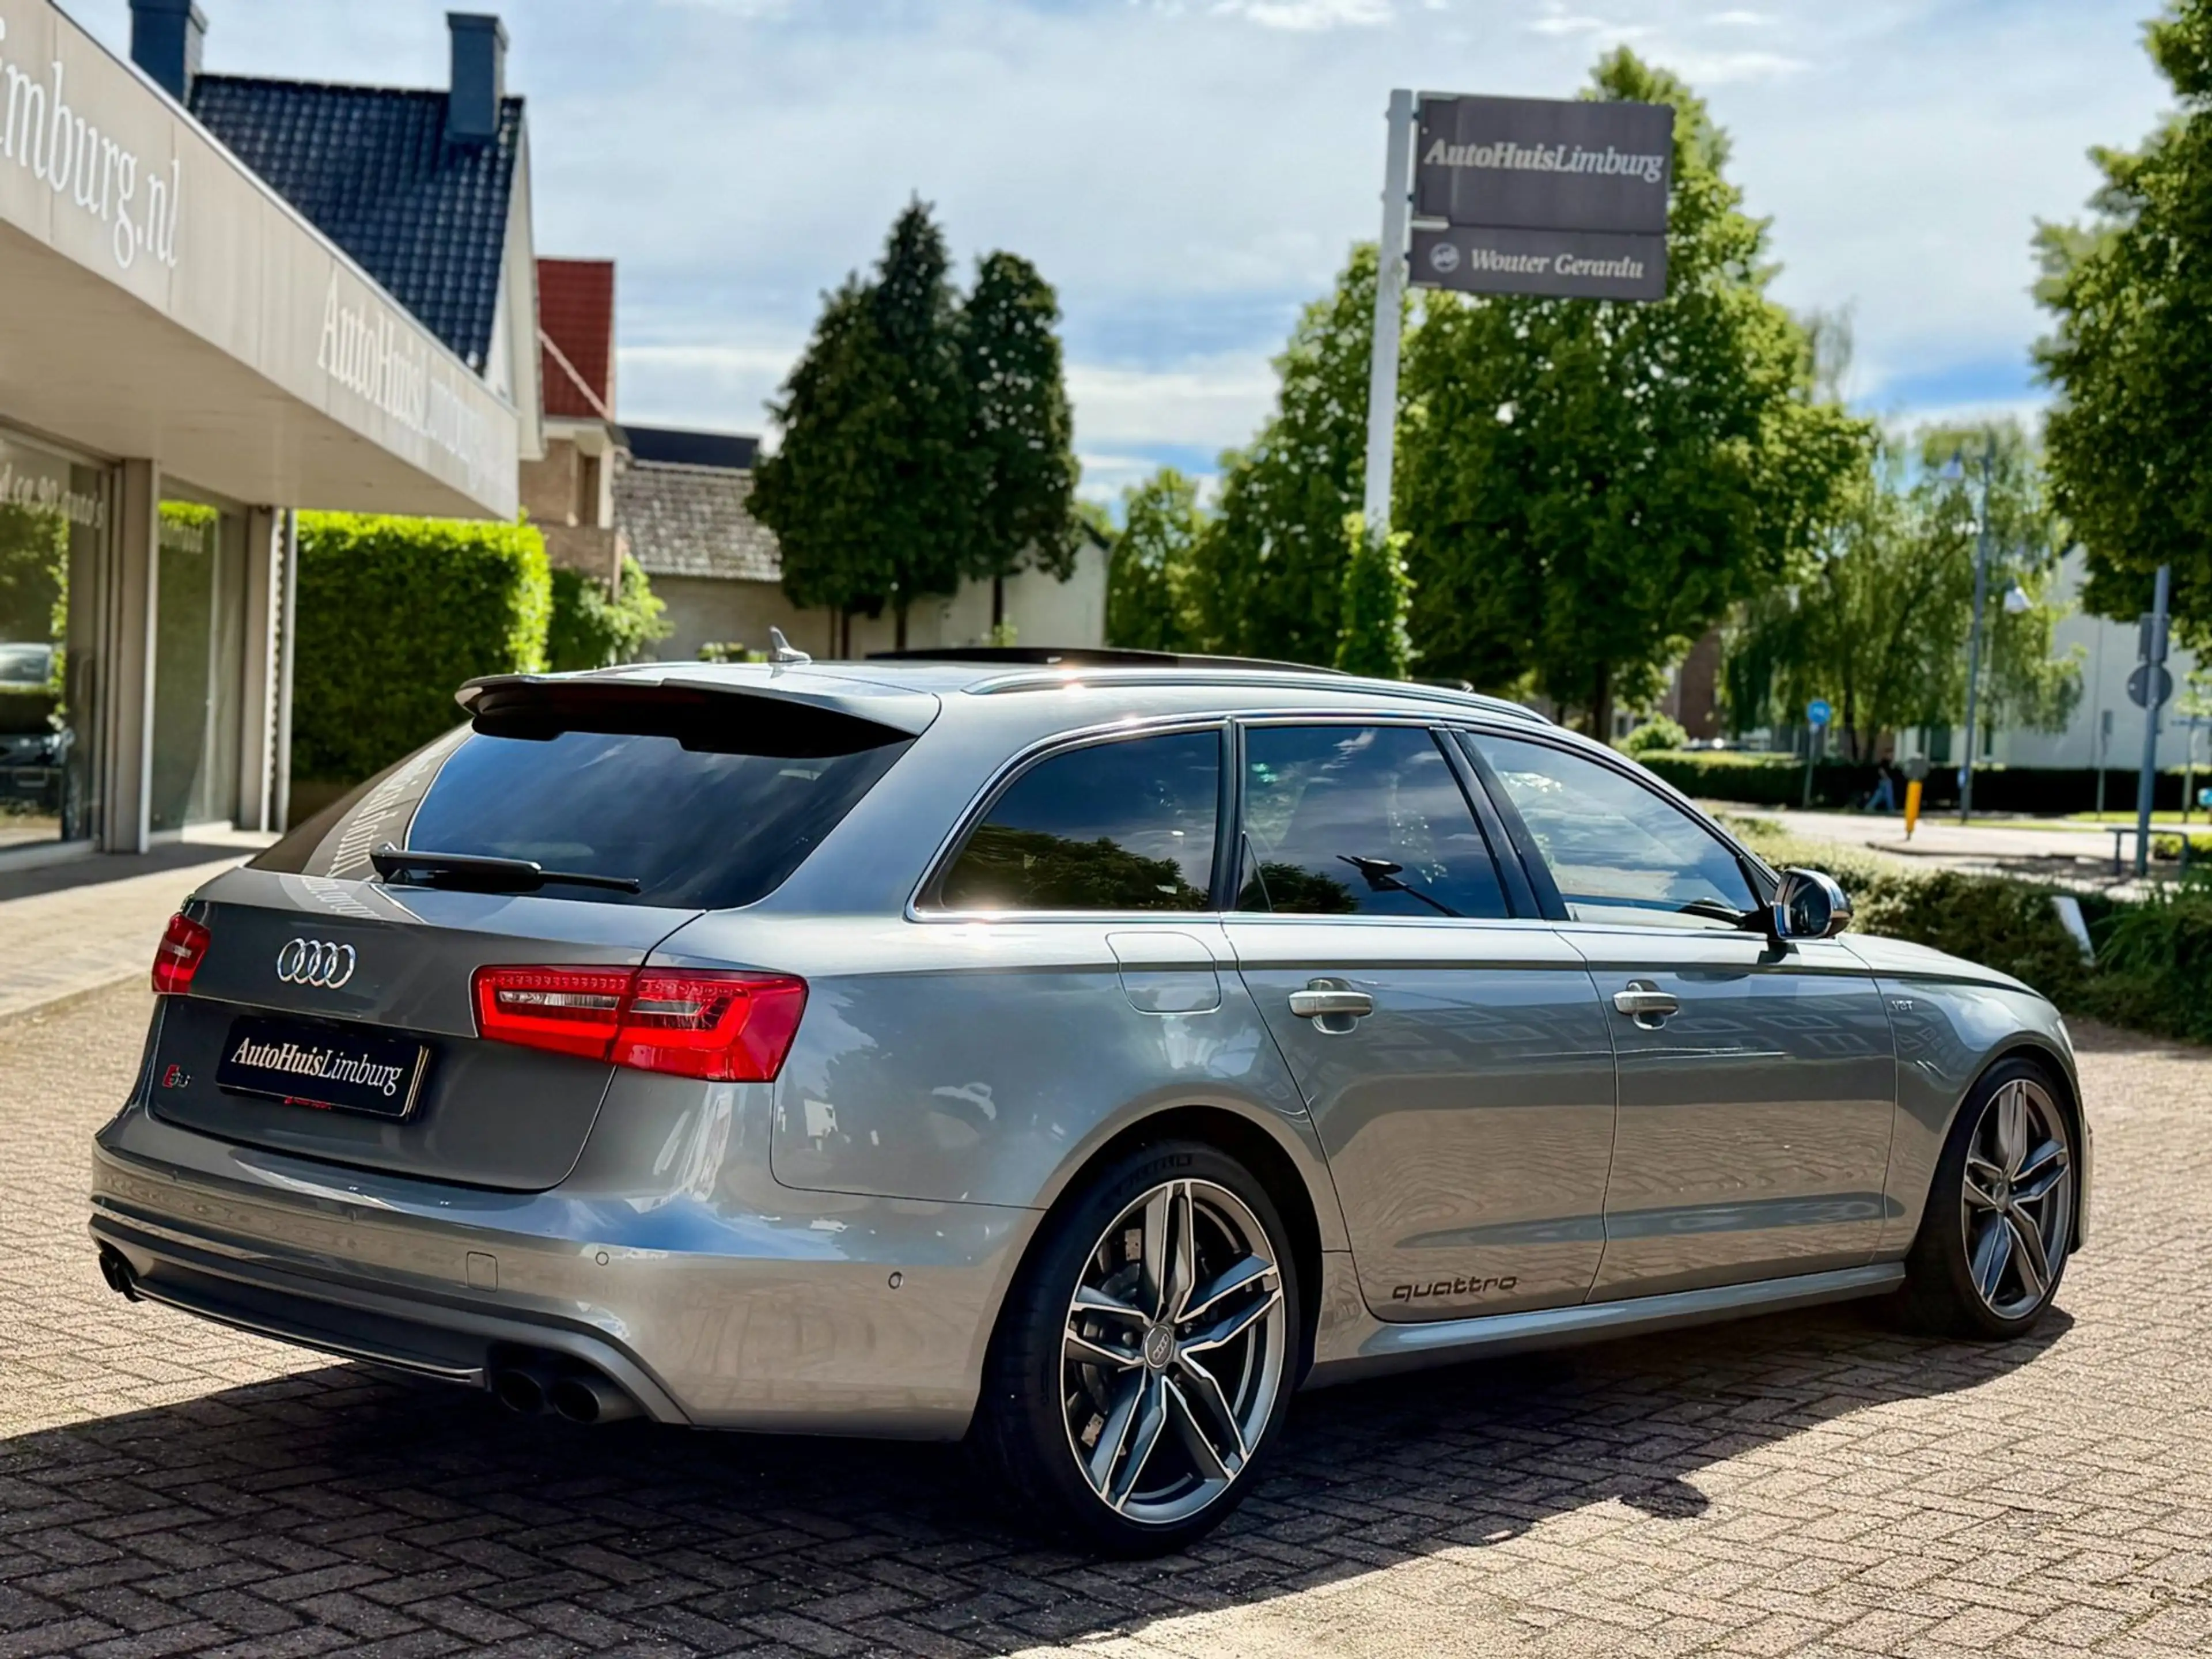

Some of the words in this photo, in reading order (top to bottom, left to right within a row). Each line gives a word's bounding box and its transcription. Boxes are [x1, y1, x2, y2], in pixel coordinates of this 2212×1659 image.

[1424, 138, 1664, 184] AutoHuisLimburg
[231, 1037, 403, 1096] AutoHuisLimburg
[1392, 1276, 1517, 1302] quattro
